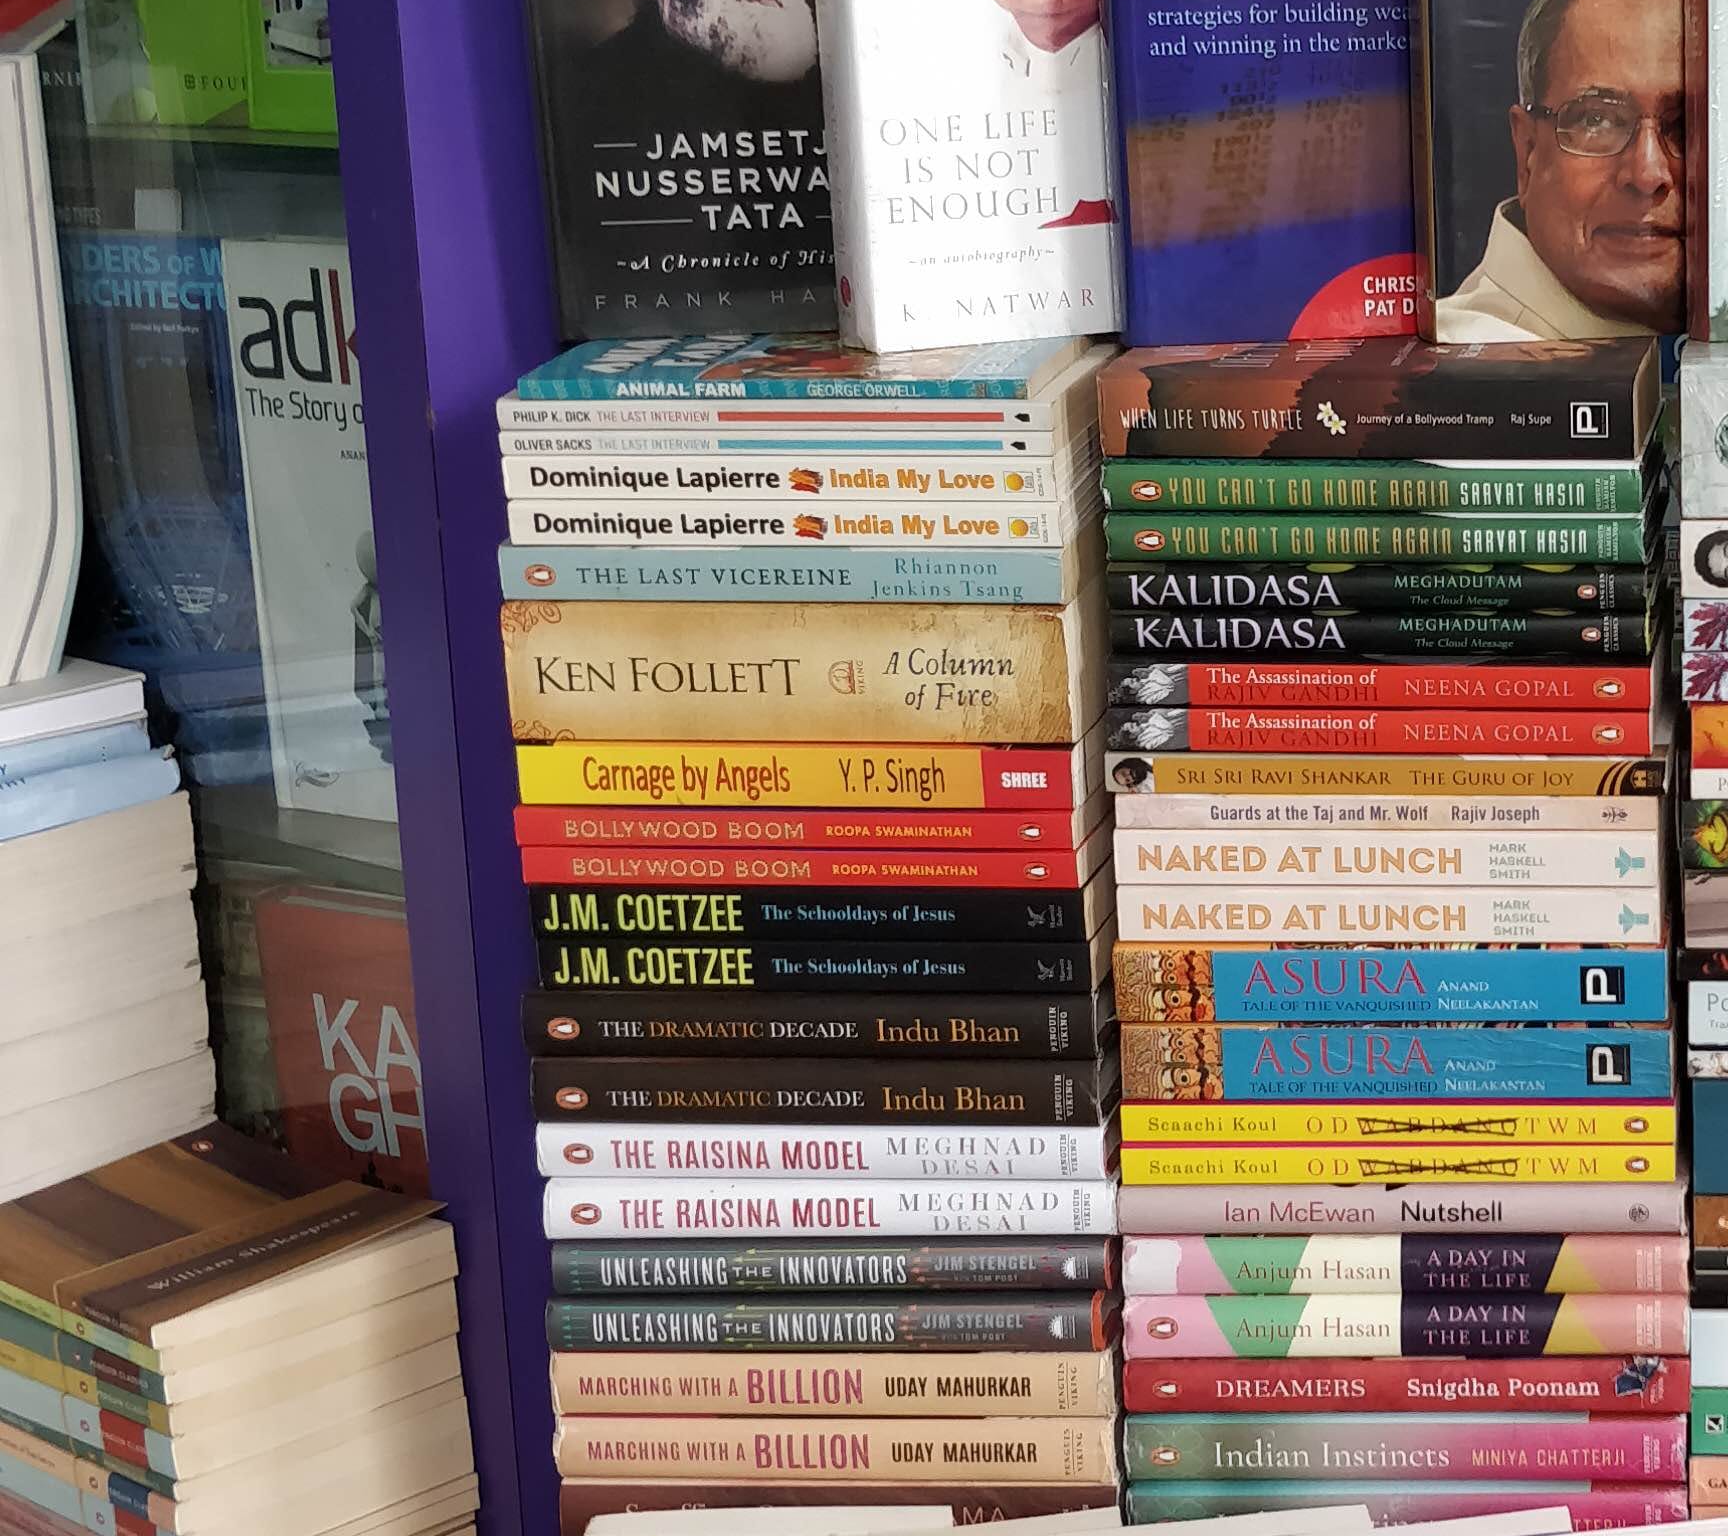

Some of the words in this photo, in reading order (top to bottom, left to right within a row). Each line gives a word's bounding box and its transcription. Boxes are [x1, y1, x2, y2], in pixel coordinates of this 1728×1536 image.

[1147, 4, 1243, 30] strategies
[1249, 4, 1278, 24] for
[1284, 1, 1368, 27] building
[879, 115, 964, 147] ONE
[983, 108, 1058, 140] LIFE
[903, 157, 934, 184] IS
[955, 149, 1040, 179] NOT
[702, 204, 805, 232] TATA
[887, 187, 1060, 225] ENOUGH
[616, 382, 689, 398] ANIMAL
[695, 382, 746, 398] FARM
[245, 389, 284, 420] The
[288, 390, 346, 431] Story
[513, 410, 546, 424] PHILIP
[548, 410, 561, 423] K.
[564, 410, 591, 423] DICK
[530, 466, 669, 492] Dominique
[675, 466, 780, 492] Lapierre
[829, 468, 891, 490] India
[896, 468, 935, 492] My
[940, 468, 995, 490] Love
[576, 568, 629, 585] THE
[638, 568, 700, 585] LAST
[711, 568, 852, 586] VICEREINE
[1128, 575, 1342, 606] KALIDASA
[535, 656, 616, 695] KEN
[631, 658, 800, 696] FOLLETT
[1403, 678, 1487, 697] NEENA
[1495, 678, 1574, 698] GOPAL
[582, 756, 676, 794] Carnage
[681, 757, 708, 803] by
[715, 756, 791, 800] Angels
[839, 759, 856, 792] Y.
[862, 759, 878, 792] P.
[885, 757, 946, 801] Singh
[1210, 804, 1262, 823] Guards
[1266, 806, 1281, 821] at
[1285, 805, 1309, 821] the
[1312, 804, 1333, 823] Taj
[1338, 804, 1366, 821] and
[1370, 805, 1391, 821] Mr.
[1396, 804, 1429, 821] Wolf
[1451, 804, 1486, 822] Rajiv
[1490, 804, 1540, 824] Joseph
[544, 894, 608, 932] J.M.
[617, 893, 744, 932] COETZEE
[1244, 958, 1427, 995] ASURA
[876, 1018, 943, 1043] Indu
[949, 1018, 1020, 1043] Bhan
[1224, 1202, 1261, 1224] Ian
[1269, 1202, 1375, 1224] McEwan
[1401, 1200, 1503, 1223] Nutshell
[885, 1376, 928, 1398] UDAY
[936, 1376, 1032, 1399] MAHURKAR
